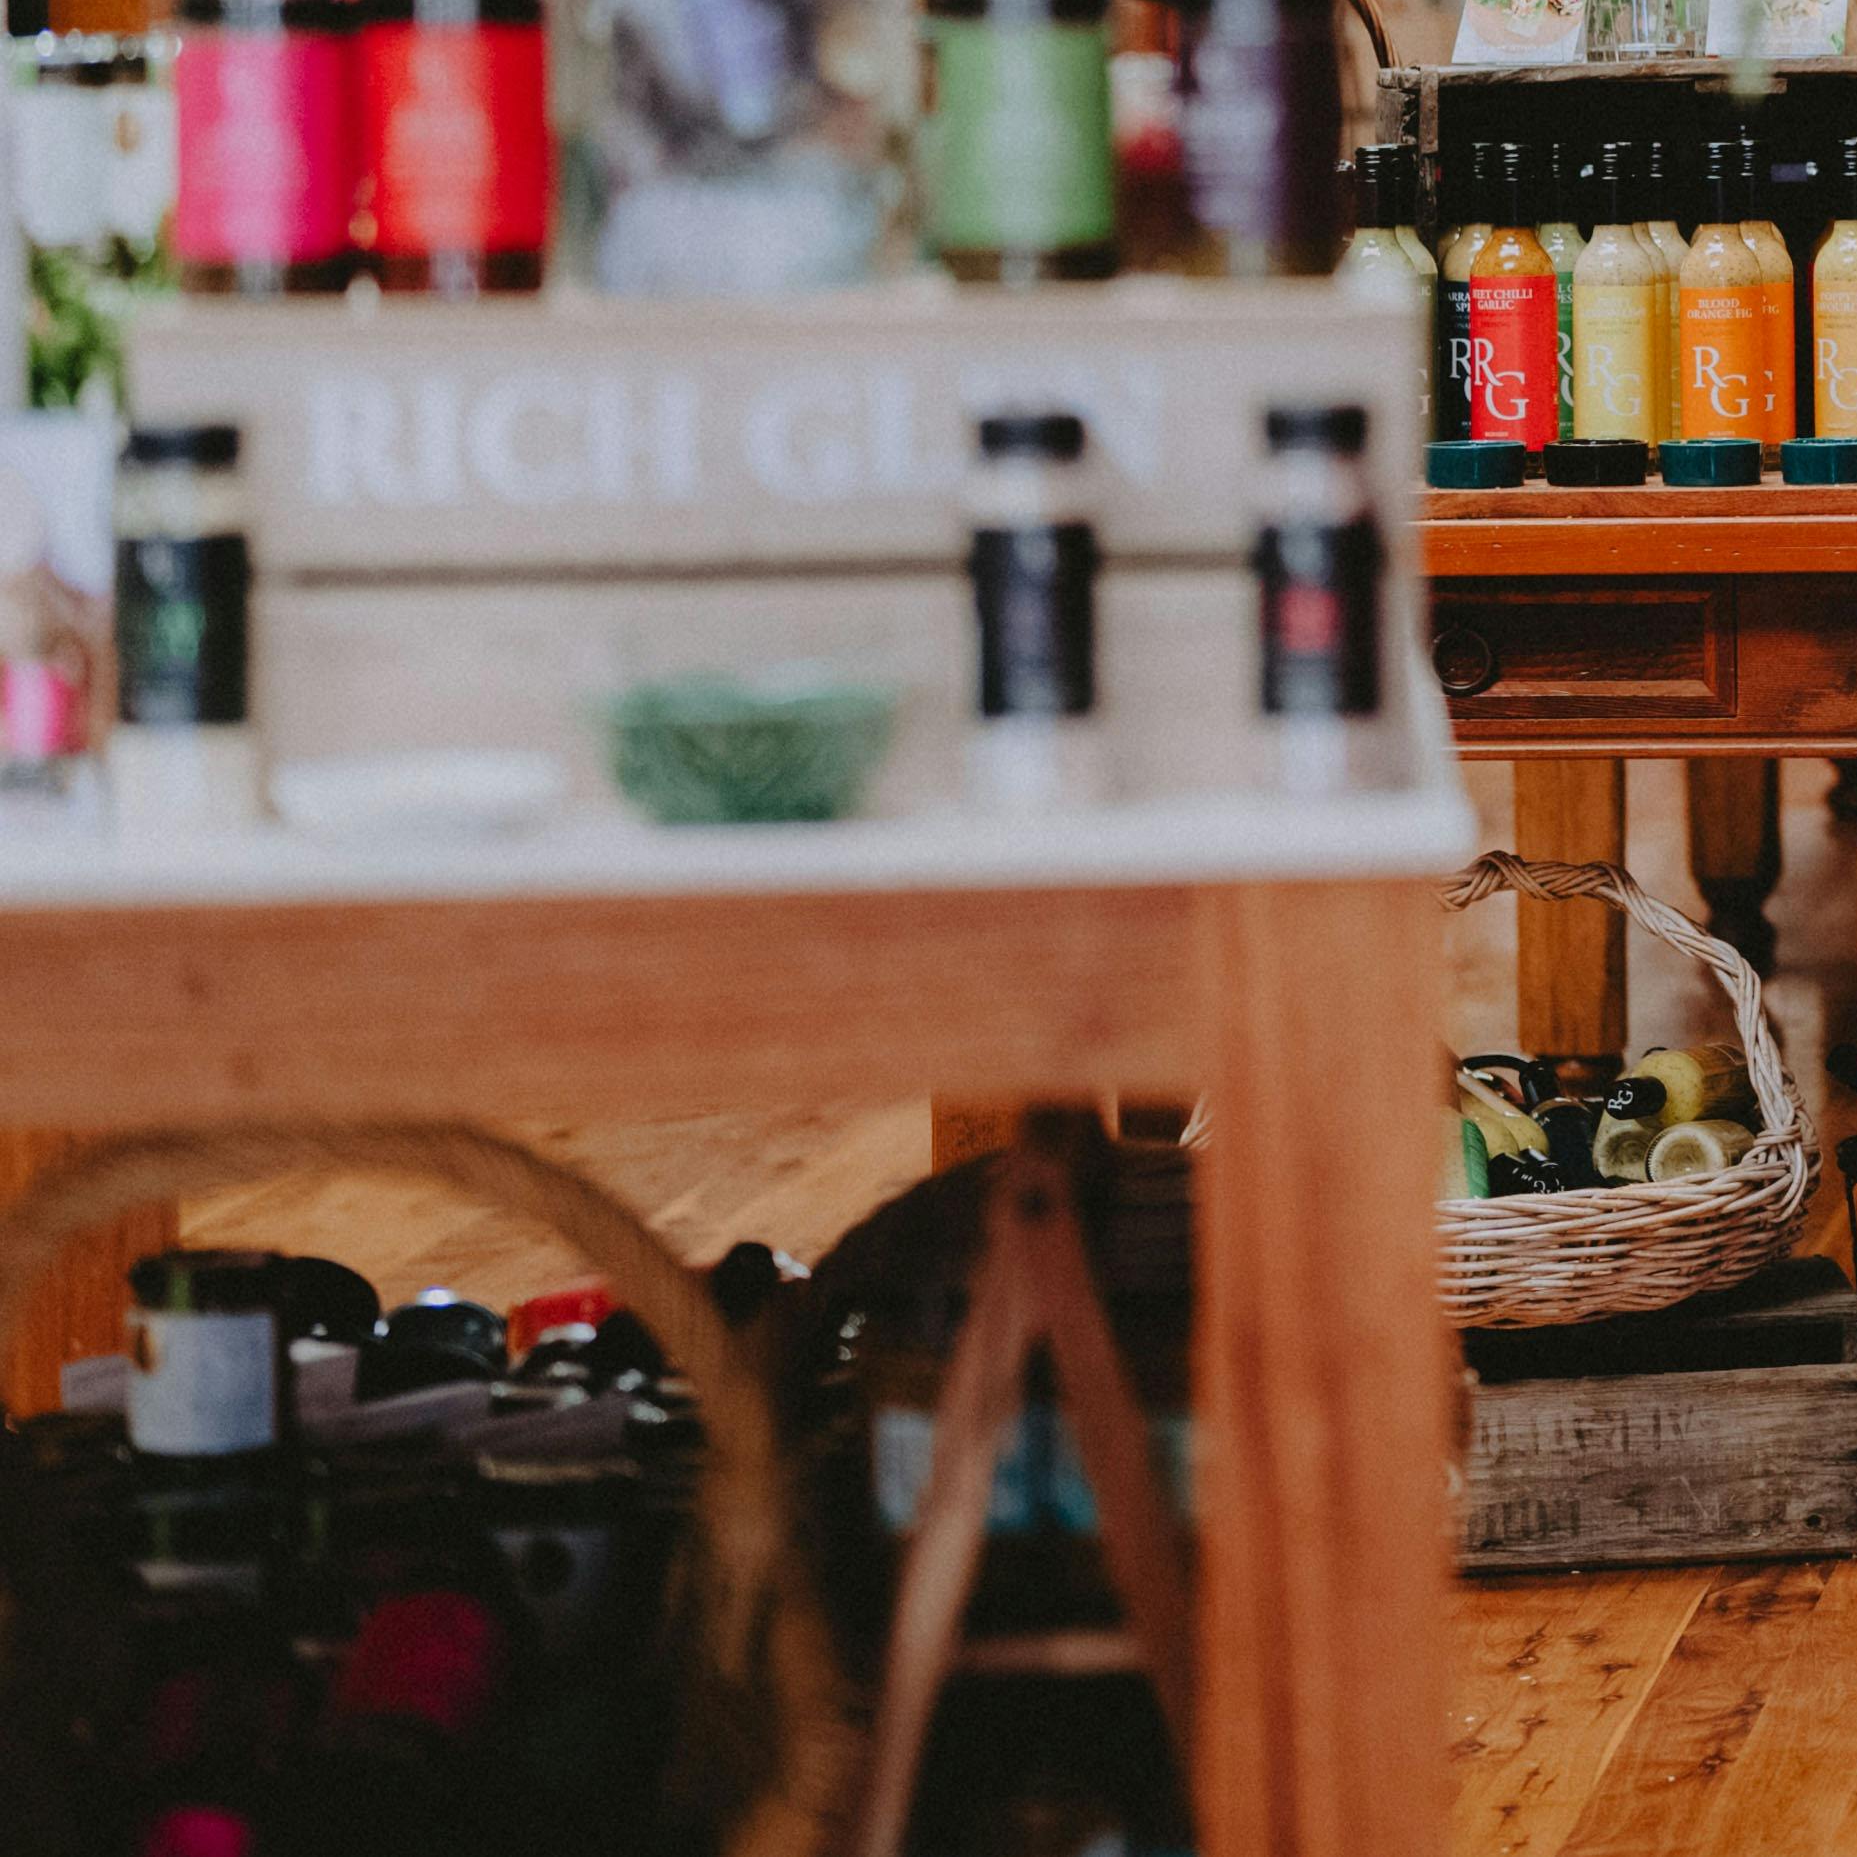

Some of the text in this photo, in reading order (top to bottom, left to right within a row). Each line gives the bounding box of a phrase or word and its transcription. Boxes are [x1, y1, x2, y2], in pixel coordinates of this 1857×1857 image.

[1477, 299, 1515, 311] GARLIC
[1494, 288, 1533, 299] CHILLI
[1687, 308, 1753, 320] ORANGE FIG
[1698, 299, 1740, 309] BLOOD
[1474, 338, 1530, 421] RG
[1587, 344, 1642, 417] RG
[1692, 345, 1750, 418] RG
[305, 368, 705, 508] RICH
